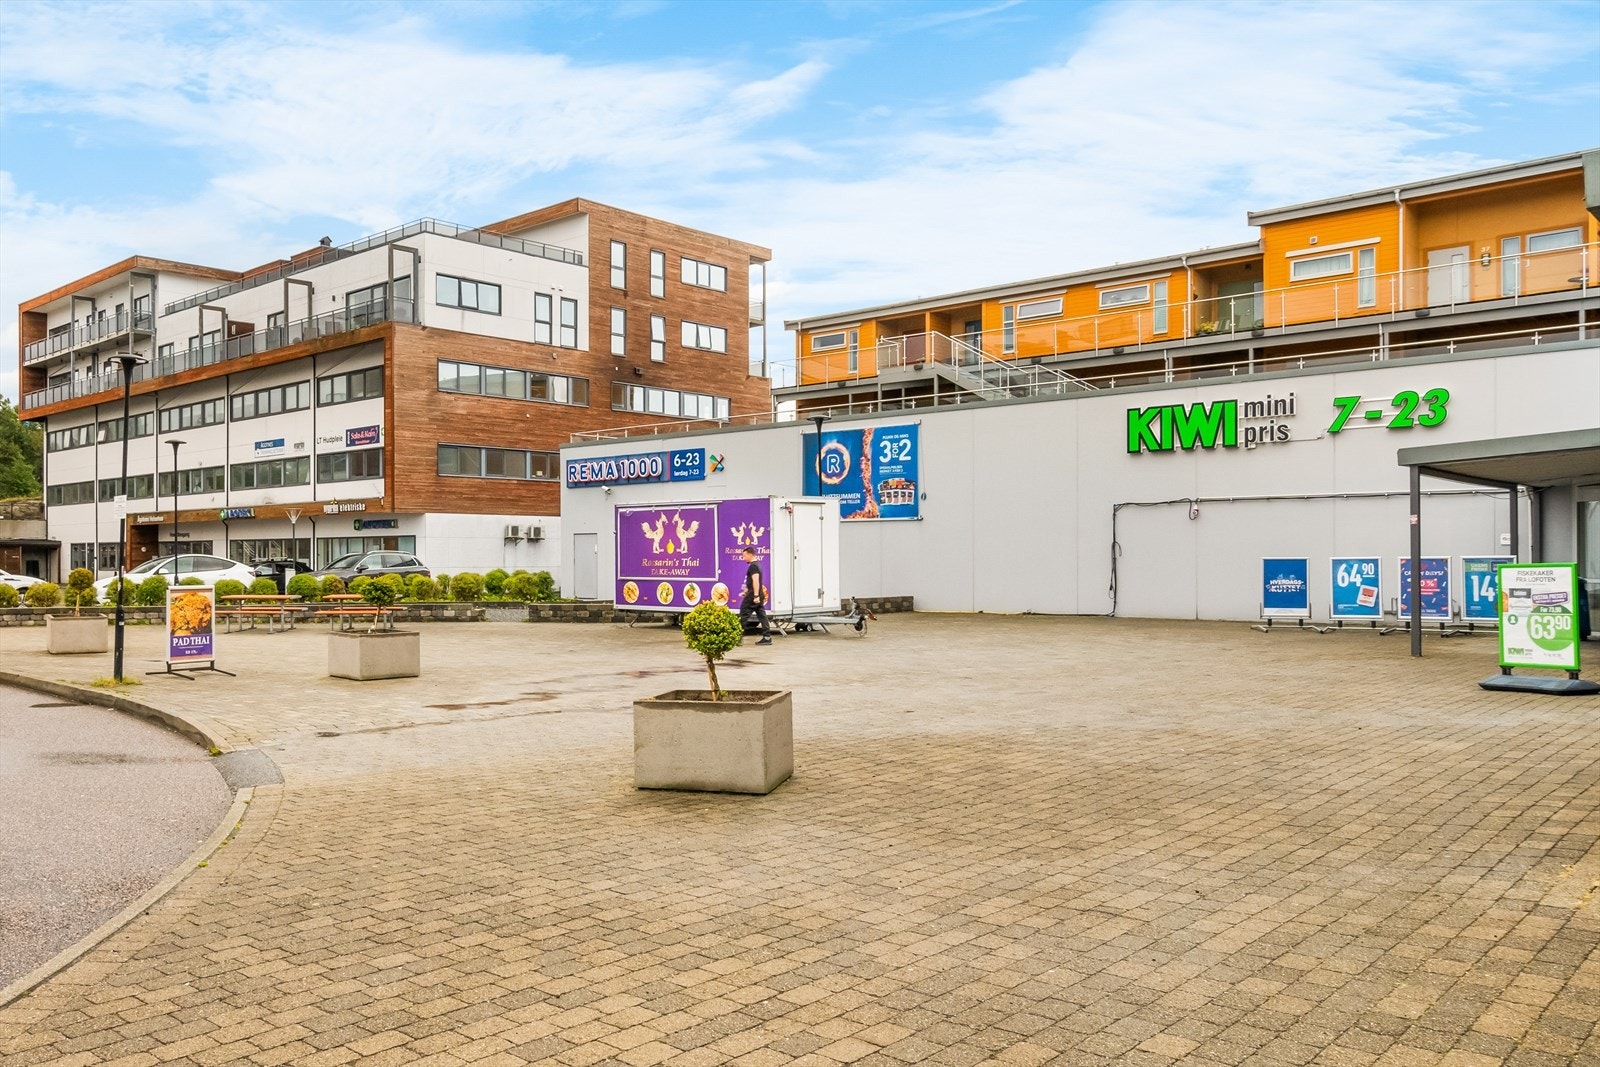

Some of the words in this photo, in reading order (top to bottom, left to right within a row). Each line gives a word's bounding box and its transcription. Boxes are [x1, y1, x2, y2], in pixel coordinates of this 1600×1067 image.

[1244, 392, 1295, 417] mini
[1127, 399, 1238, 453] KIWI
[1244, 420, 1289, 448] pris
[673, 452, 700, 467] 6-23
[880, 441, 891, 462] 3
[899, 439, 912, 461] 2
[568, 460, 618, 483] REMA
[619, 456, 663, 479] 1000
[827, 454, 840, 473] R
[642, 558, 679, 567] Rossarin's
[681, 556, 700, 567] Thai
[651, 568, 690, 576] TAKE-AWAY
[173, 637, 190, 646] PAD
[190, 636, 209, 645] THAI
